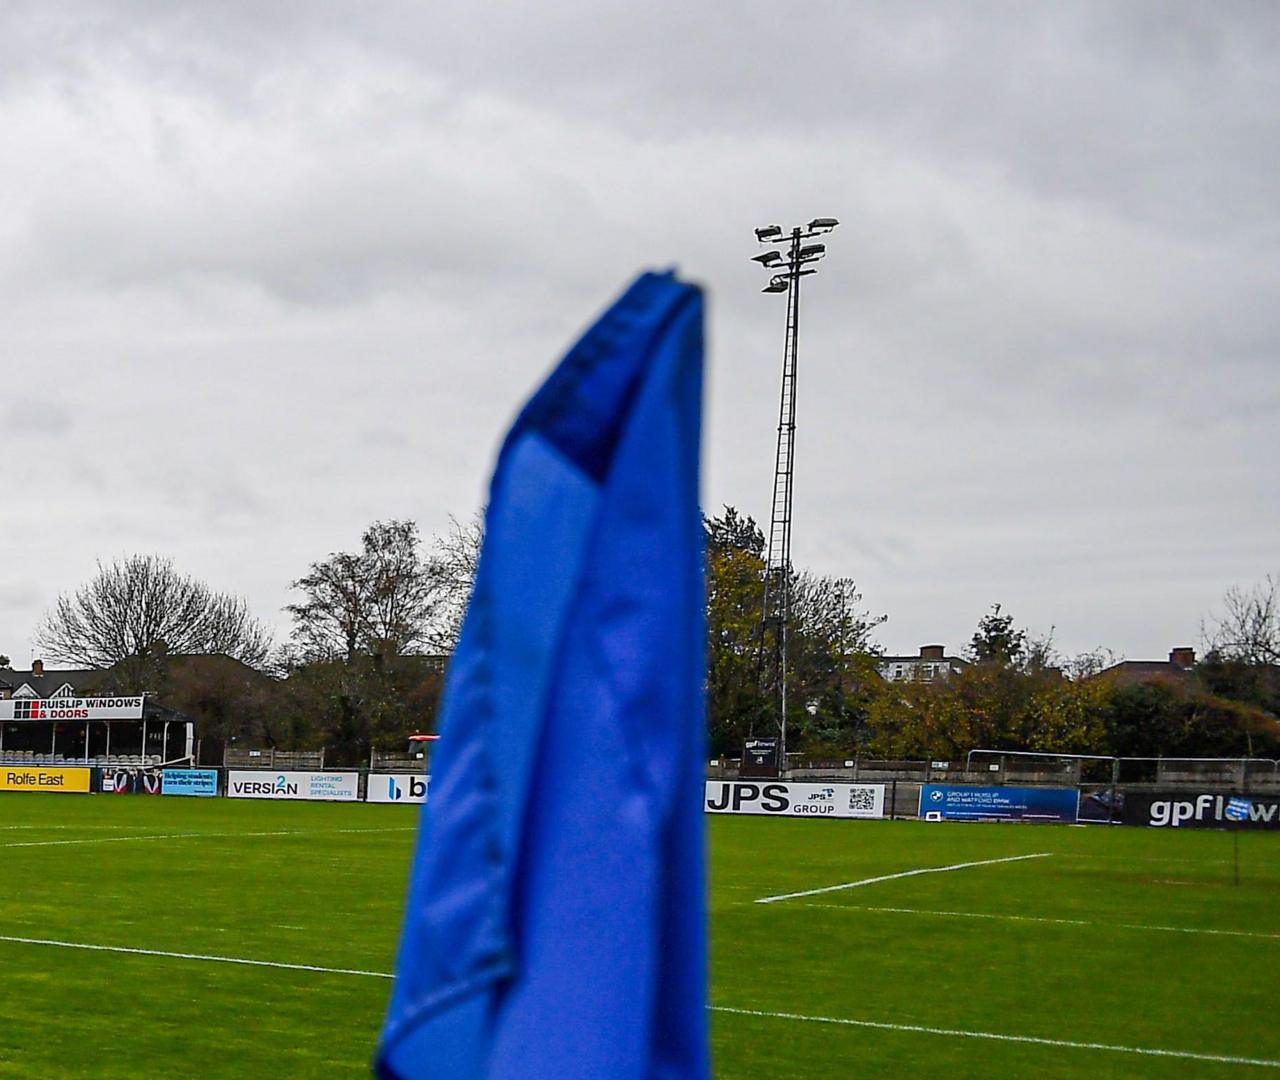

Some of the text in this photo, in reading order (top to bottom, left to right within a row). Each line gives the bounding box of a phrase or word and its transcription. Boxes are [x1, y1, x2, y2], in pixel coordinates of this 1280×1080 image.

[40, 699, 83, 709] RUISLIP
[39, 709, 89, 719] & DOORS
[7, 772, 64, 786] Rolfe East
[707, 783, 790, 812] JPS
[793, 804, 835, 814] GROUP
